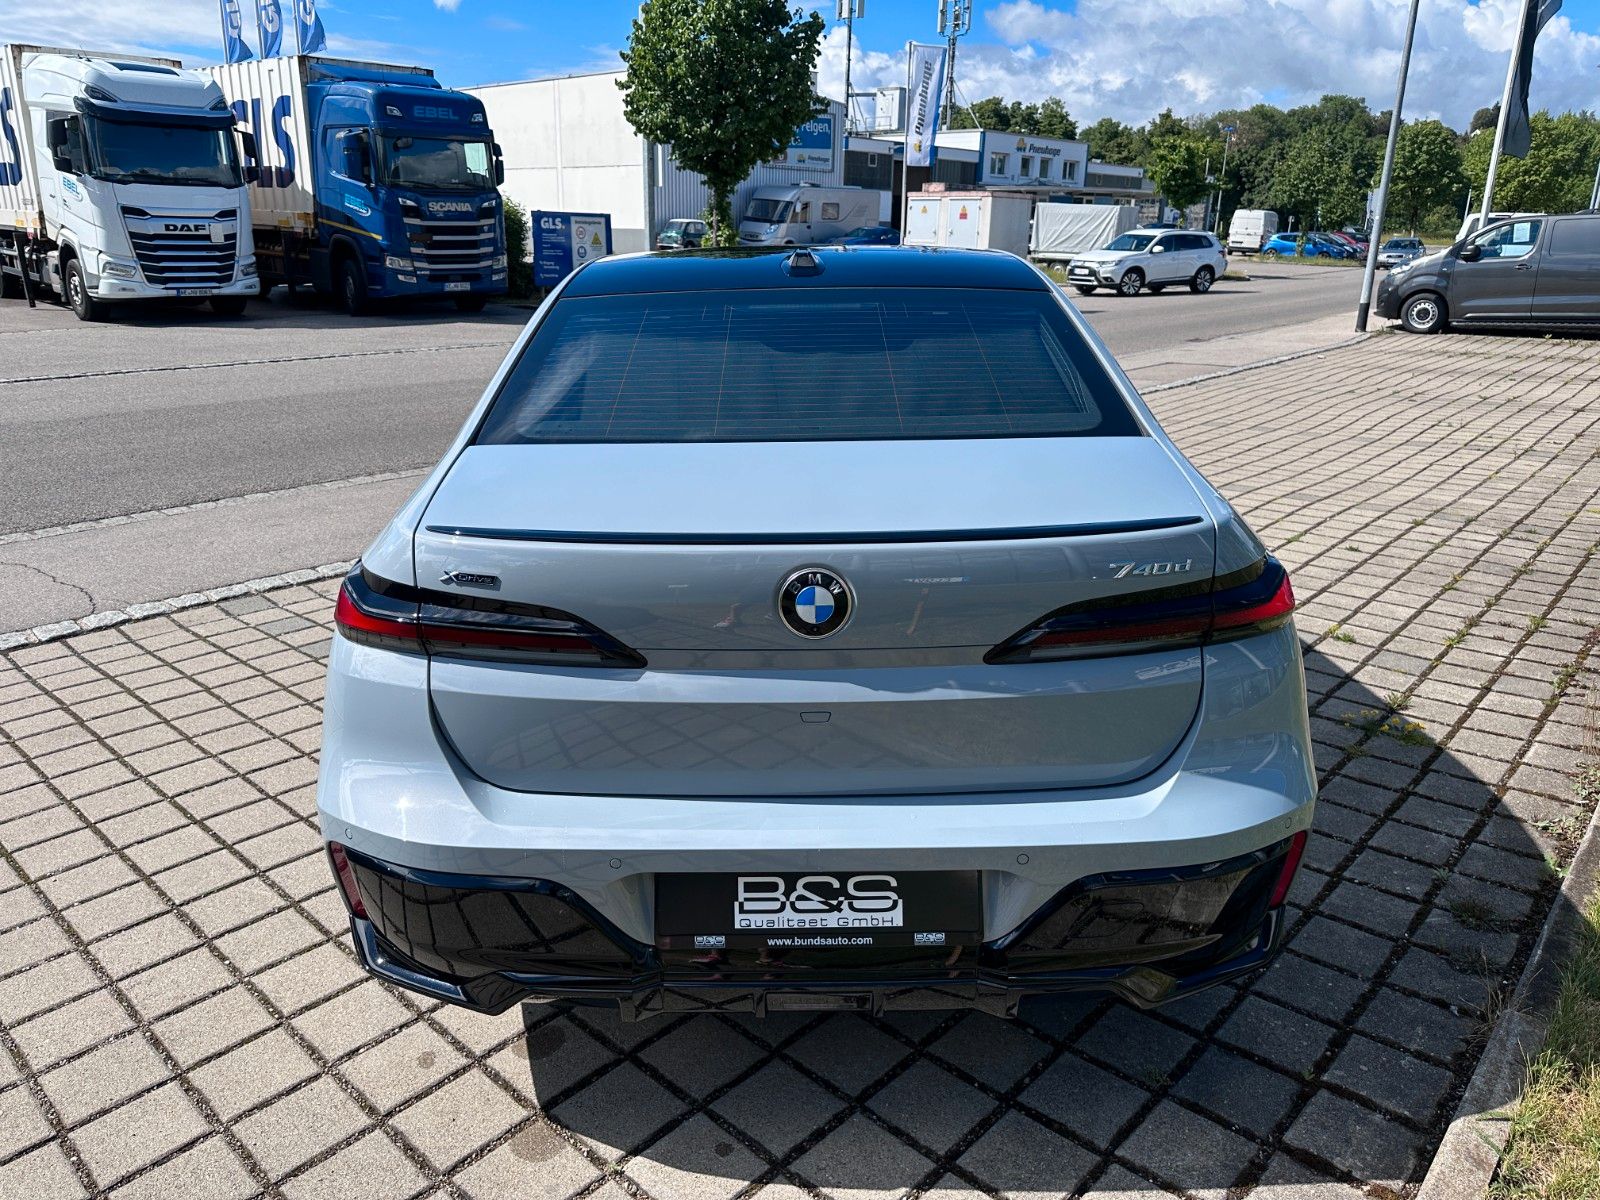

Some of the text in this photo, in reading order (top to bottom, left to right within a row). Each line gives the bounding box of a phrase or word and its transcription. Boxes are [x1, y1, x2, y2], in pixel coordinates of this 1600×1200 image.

[915, 60, 933, 136] Pneuhage
[413, 105, 460, 120] EBEL
[1029, 143, 1062, 157] Pneuhage
[63, 176, 80, 195] EBEL
[428, 201, 473, 212] SCANIA
[164, 223, 207, 232] DAF
[1109, 559, 1193, 579] 740d
[788, 573, 843, 595] BMW
[737, 875, 899, 914] B&S
[739, 916, 828, 928] Qualitaet
[766, 935, 873, 946] www.bundsauto.com
